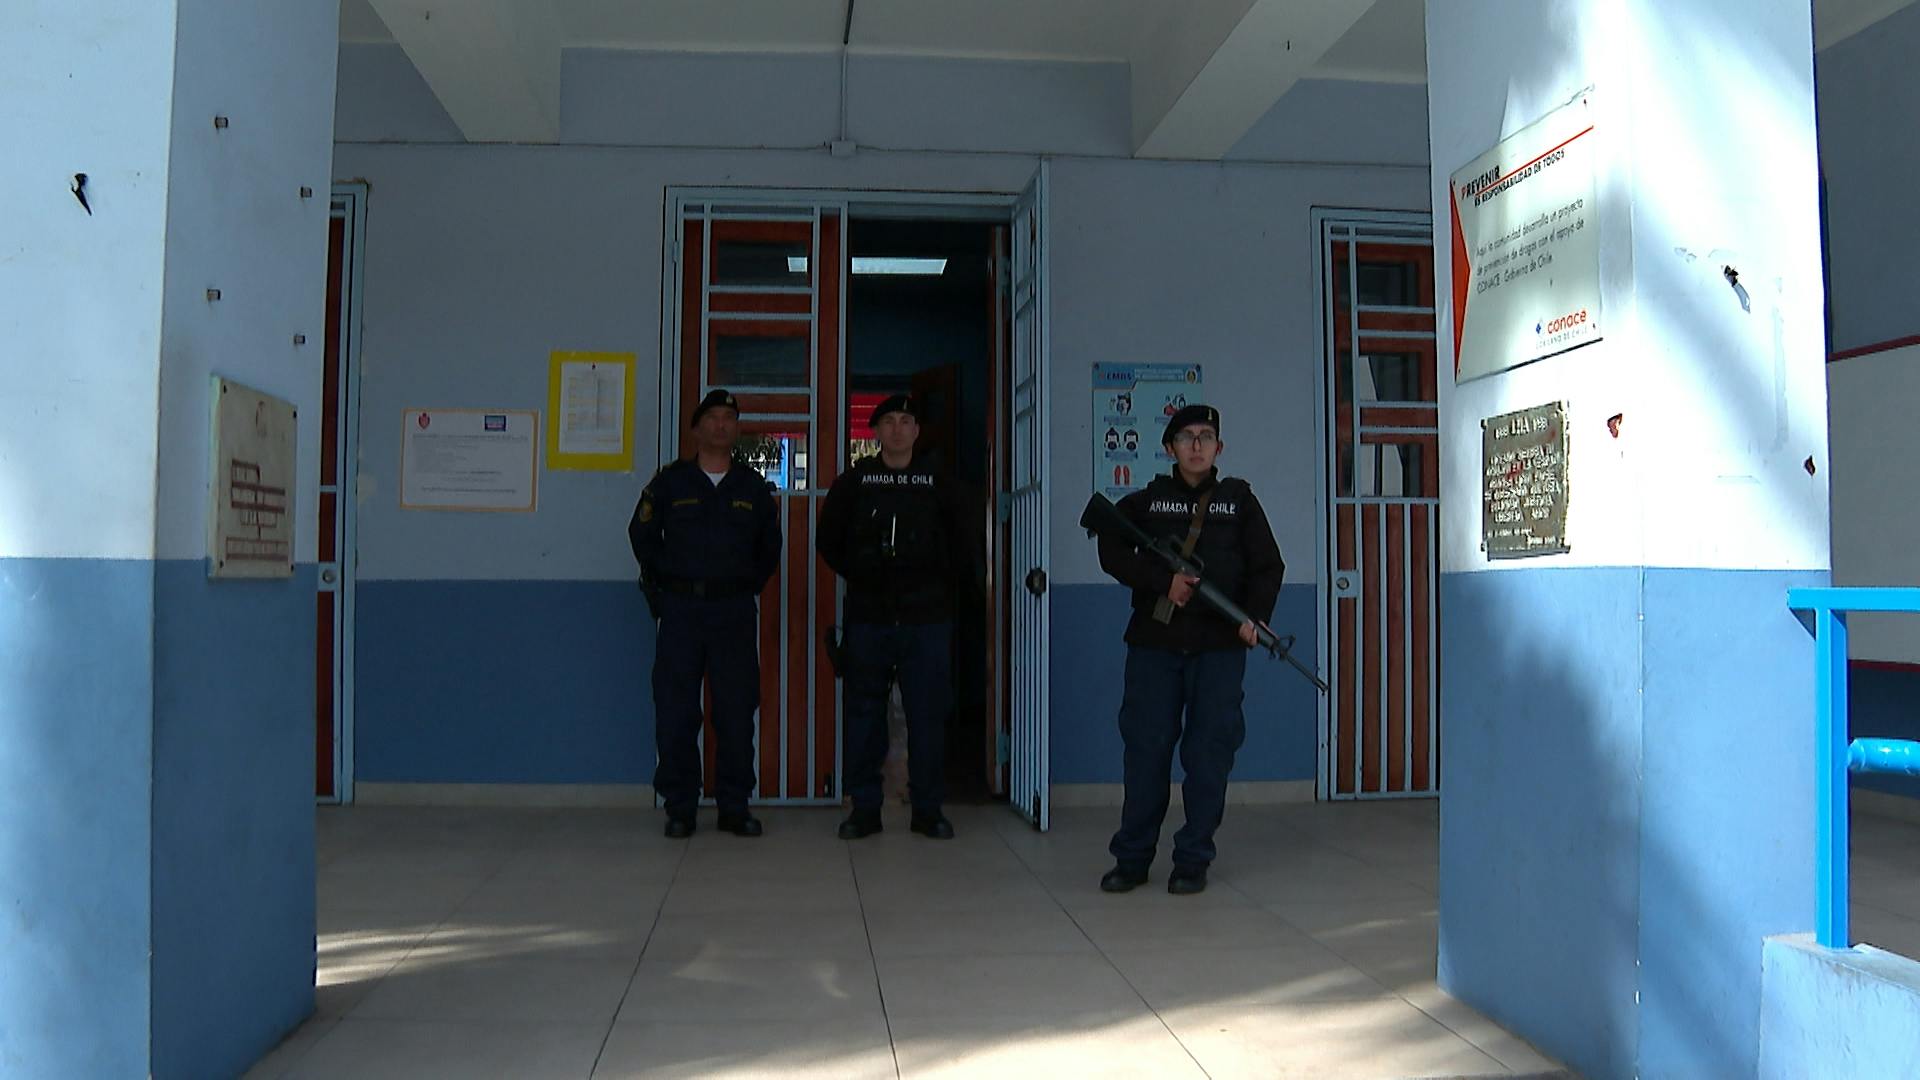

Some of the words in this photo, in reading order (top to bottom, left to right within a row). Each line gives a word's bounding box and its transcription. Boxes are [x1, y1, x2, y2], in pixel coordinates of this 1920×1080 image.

[1461, 165, 1501, 200] PREVENIR
[1482, 167, 1532, 203] RESPONSABILIDAD
[1534, 161, 1541, 174] DE
[1543, 149, 1565, 168] TODOS
[1494, 225, 1521, 250] comunidad
[1522, 212, 1549, 237] desarrolla
[1550, 210, 1557, 222] un
[1558, 198, 1584, 221] proyecto
[1511, 247, 1518, 260] de
[1519, 239, 1537, 257] drogas
[1575, 215, 1584, 230] de
[1529, 257, 1536, 272] de
[1547, 310, 1587, 334] conace
[861, 474, 895, 485] ARMADA
[897, 474, 908, 485] DE
[911, 474, 934, 486] CHILE
[1149, 501, 1189, 514] ARMADA
[1209, 502, 1237, 514] CHILE
